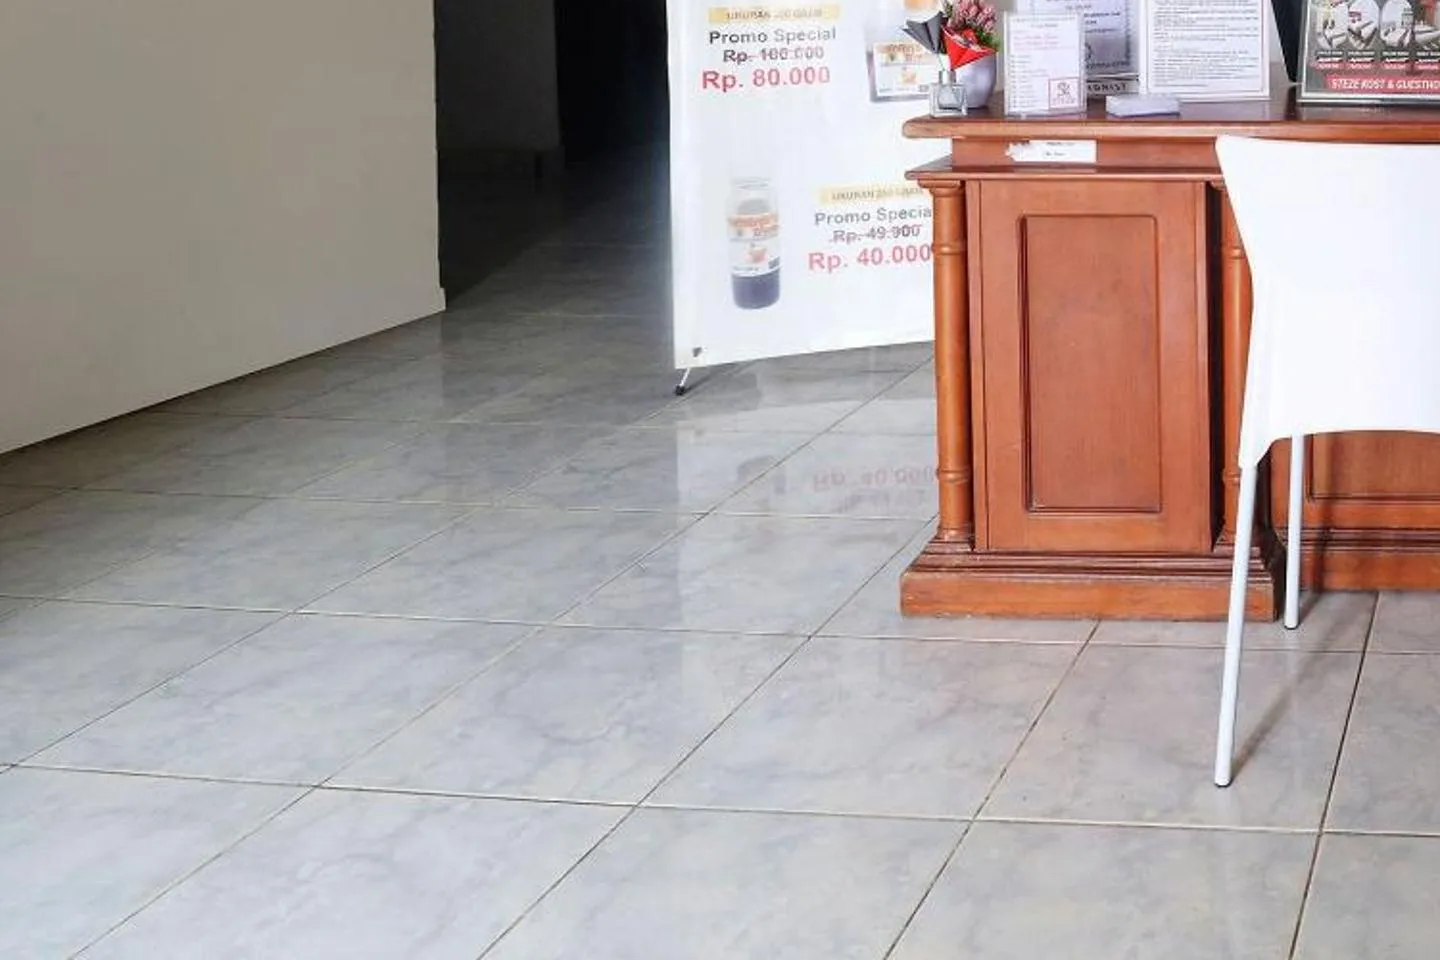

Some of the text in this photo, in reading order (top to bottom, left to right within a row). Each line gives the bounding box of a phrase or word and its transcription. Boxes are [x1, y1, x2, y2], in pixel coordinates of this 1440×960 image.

[709, 26, 837, 45] Promo Special
[701, 66, 831, 93] Rp. 80.000
[814, 206, 932, 226] Promo Specia
[808, 243, 932, 273] Rp. 40.000
